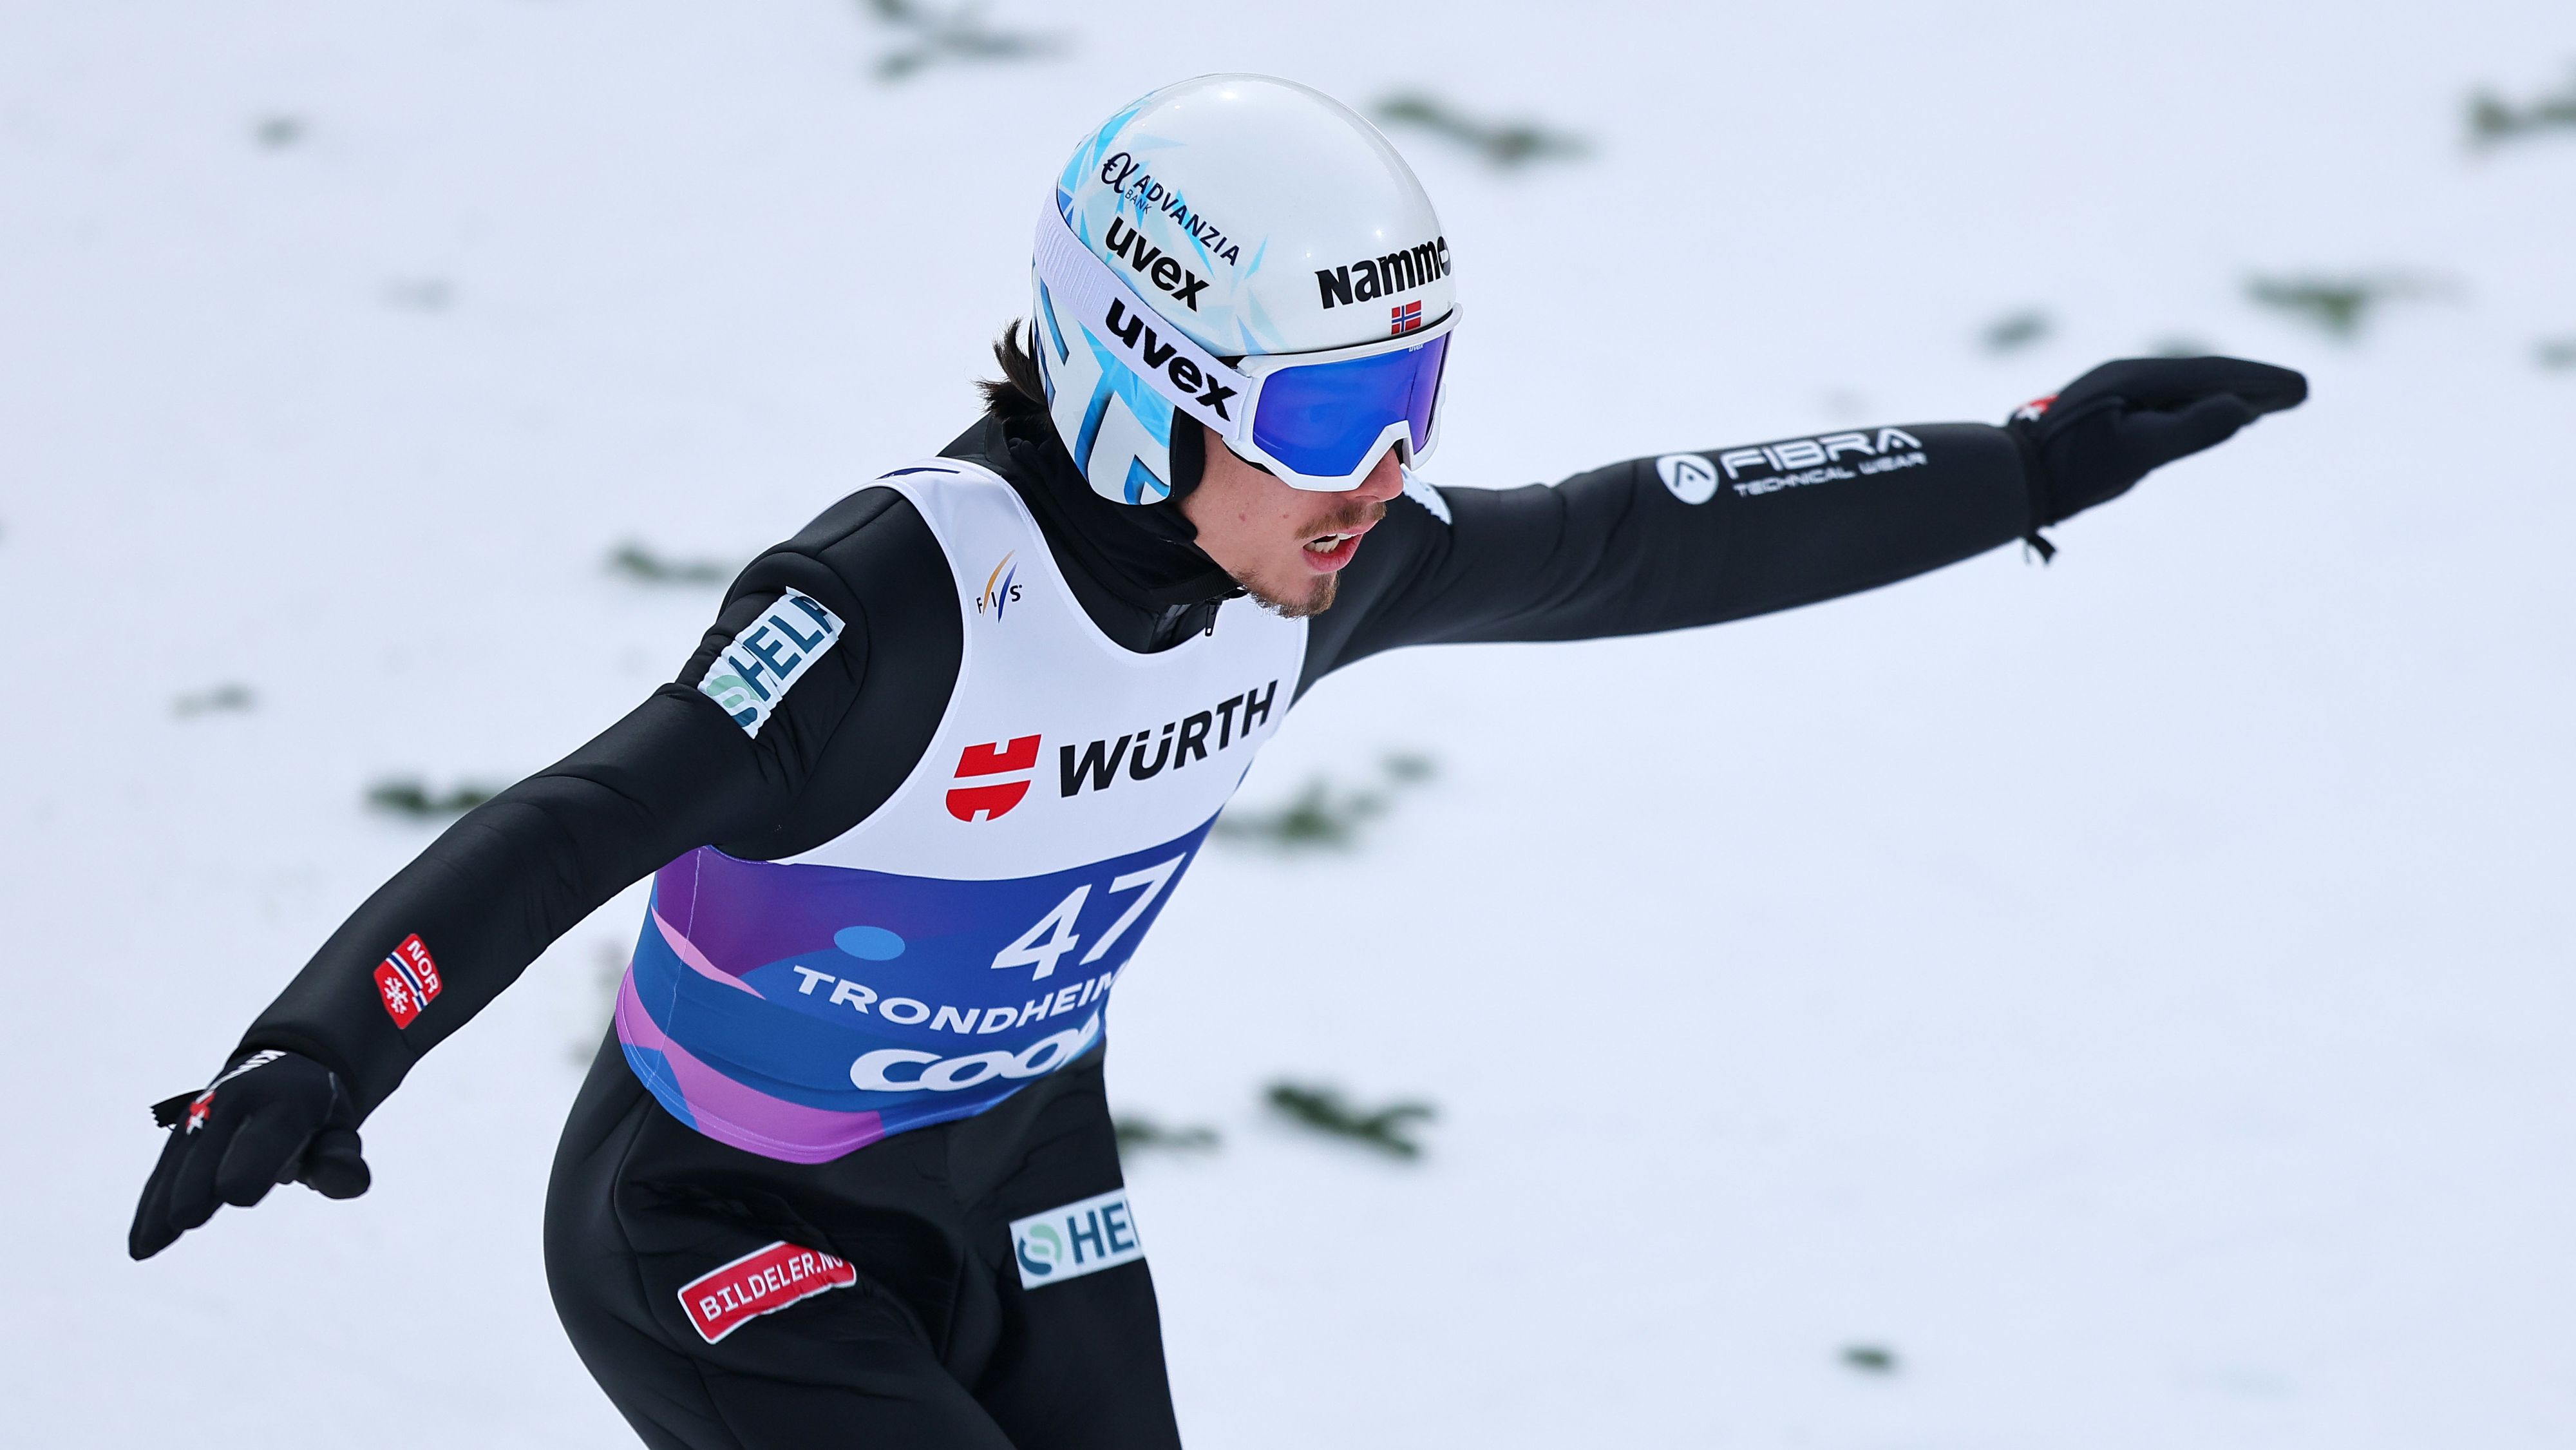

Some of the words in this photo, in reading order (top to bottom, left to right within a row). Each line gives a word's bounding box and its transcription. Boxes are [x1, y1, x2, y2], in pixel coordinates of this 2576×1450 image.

[1124, 189, 1152, 215] BANK
[1133, 175, 1240, 266] ADVANZIA
[1106, 216, 1209, 312] uvex
[1314, 236, 1451, 309] Nammo
[1105, 297, 1237, 422] uvex
[1719, 428, 1923, 480] FIBRA
[1733, 466, 1856, 498] TECHNICAL
[1858, 452, 1928, 475] WEAR
[976, 584, 1023, 614] FIS
[1059, 680, 1278, 797] WÜRTH
[990, 852, 1186, 981] 47
[407, 940, 439, 994] NOR
[1067, 1199, 1140, 1265] HE
